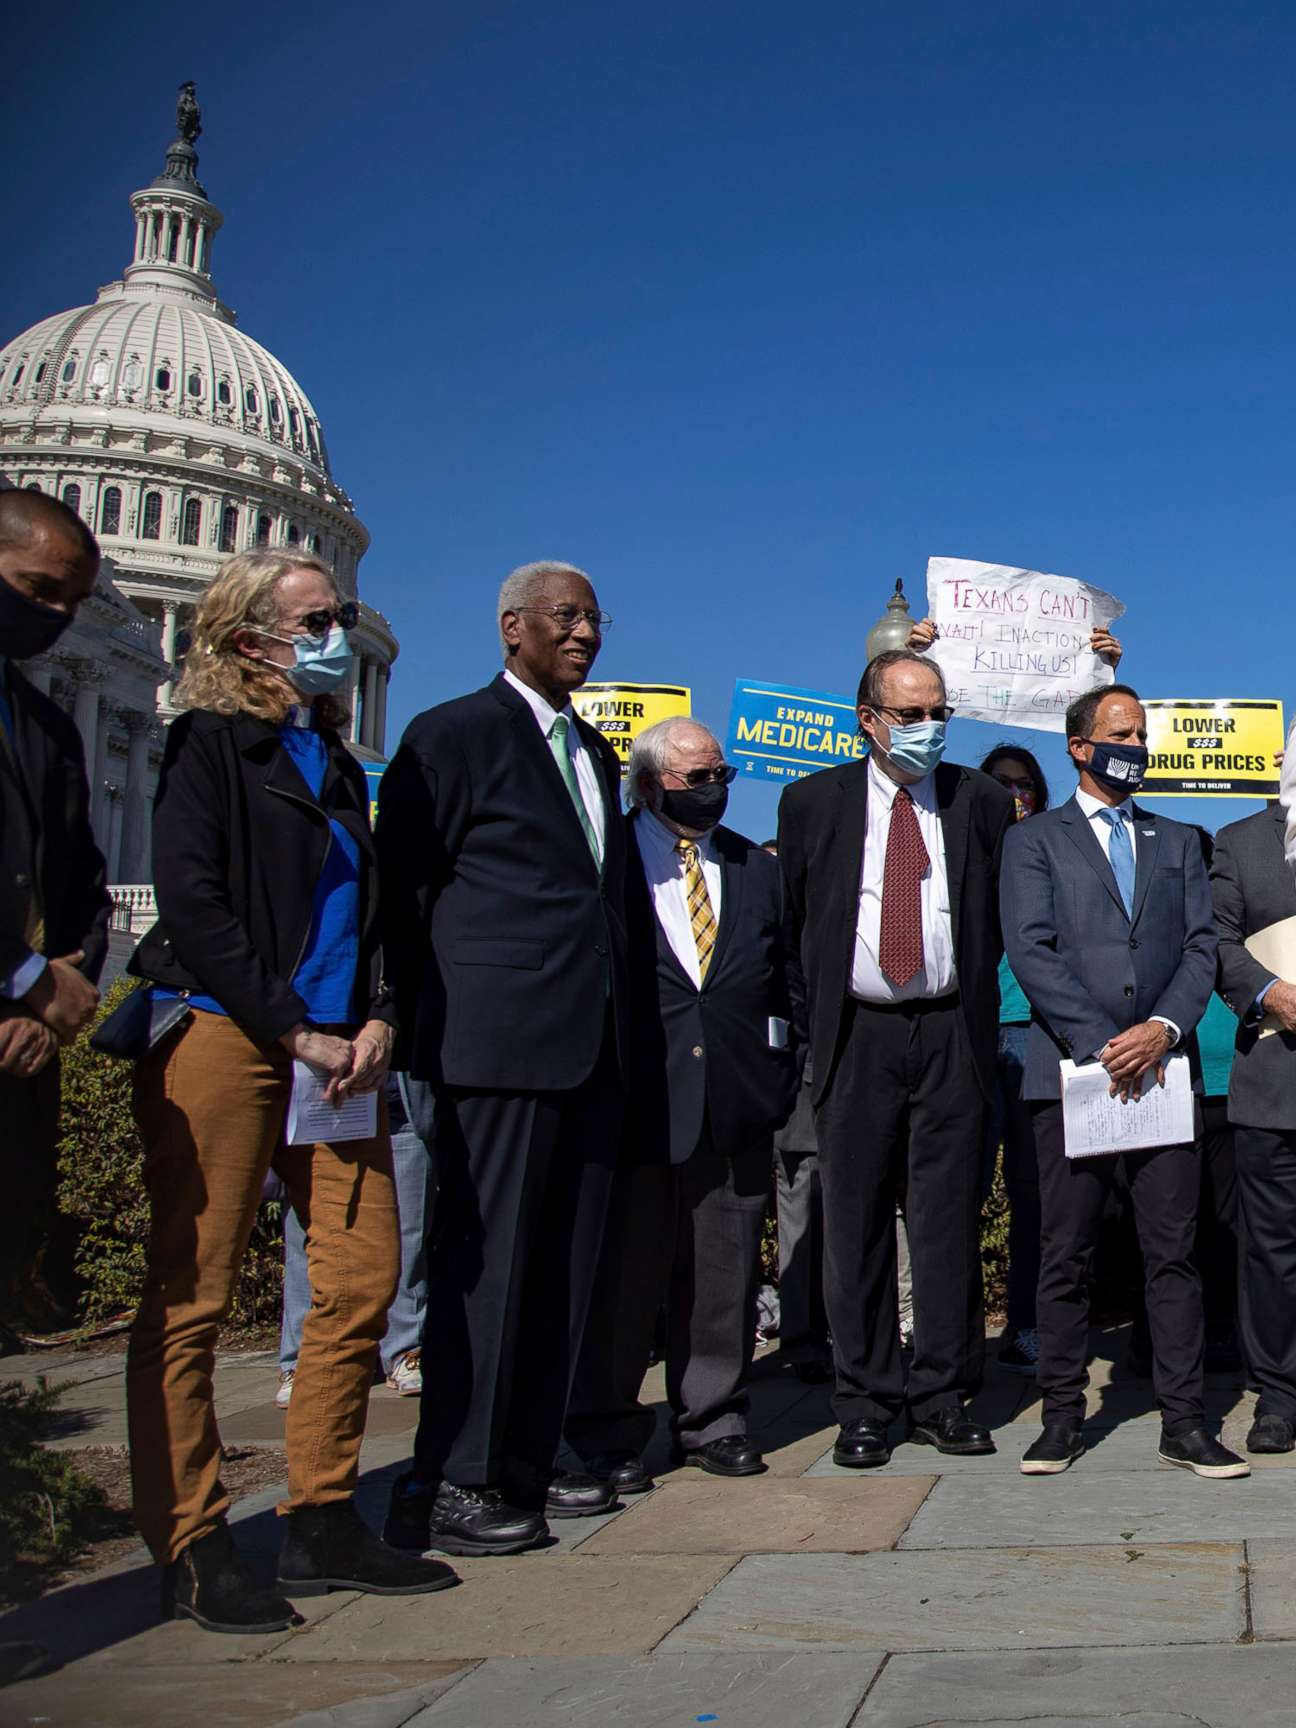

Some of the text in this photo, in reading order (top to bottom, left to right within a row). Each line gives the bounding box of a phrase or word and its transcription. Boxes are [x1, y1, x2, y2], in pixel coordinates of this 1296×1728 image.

[944, 579, 1090, 619] TEXANS CAN'T
[993, 624, 1082, 650] INACTION
[973, 646, 1046, 674] KILLING
[978, 684, 1017, 707] THE
[582, 702, 644, 717] LOWER
[777, 707, 834, 727] EXPAND
[1173, 718, 1236, 733] LOWER
[736, 717, 866, 759] MEDICARE
[766, 765, 784, 775] TIME
[786, 767, 795, 776] TO
[1147, 753, 1265, 771] DRUG PRICES
[1207, 782, 1232, 790] DELIVER
